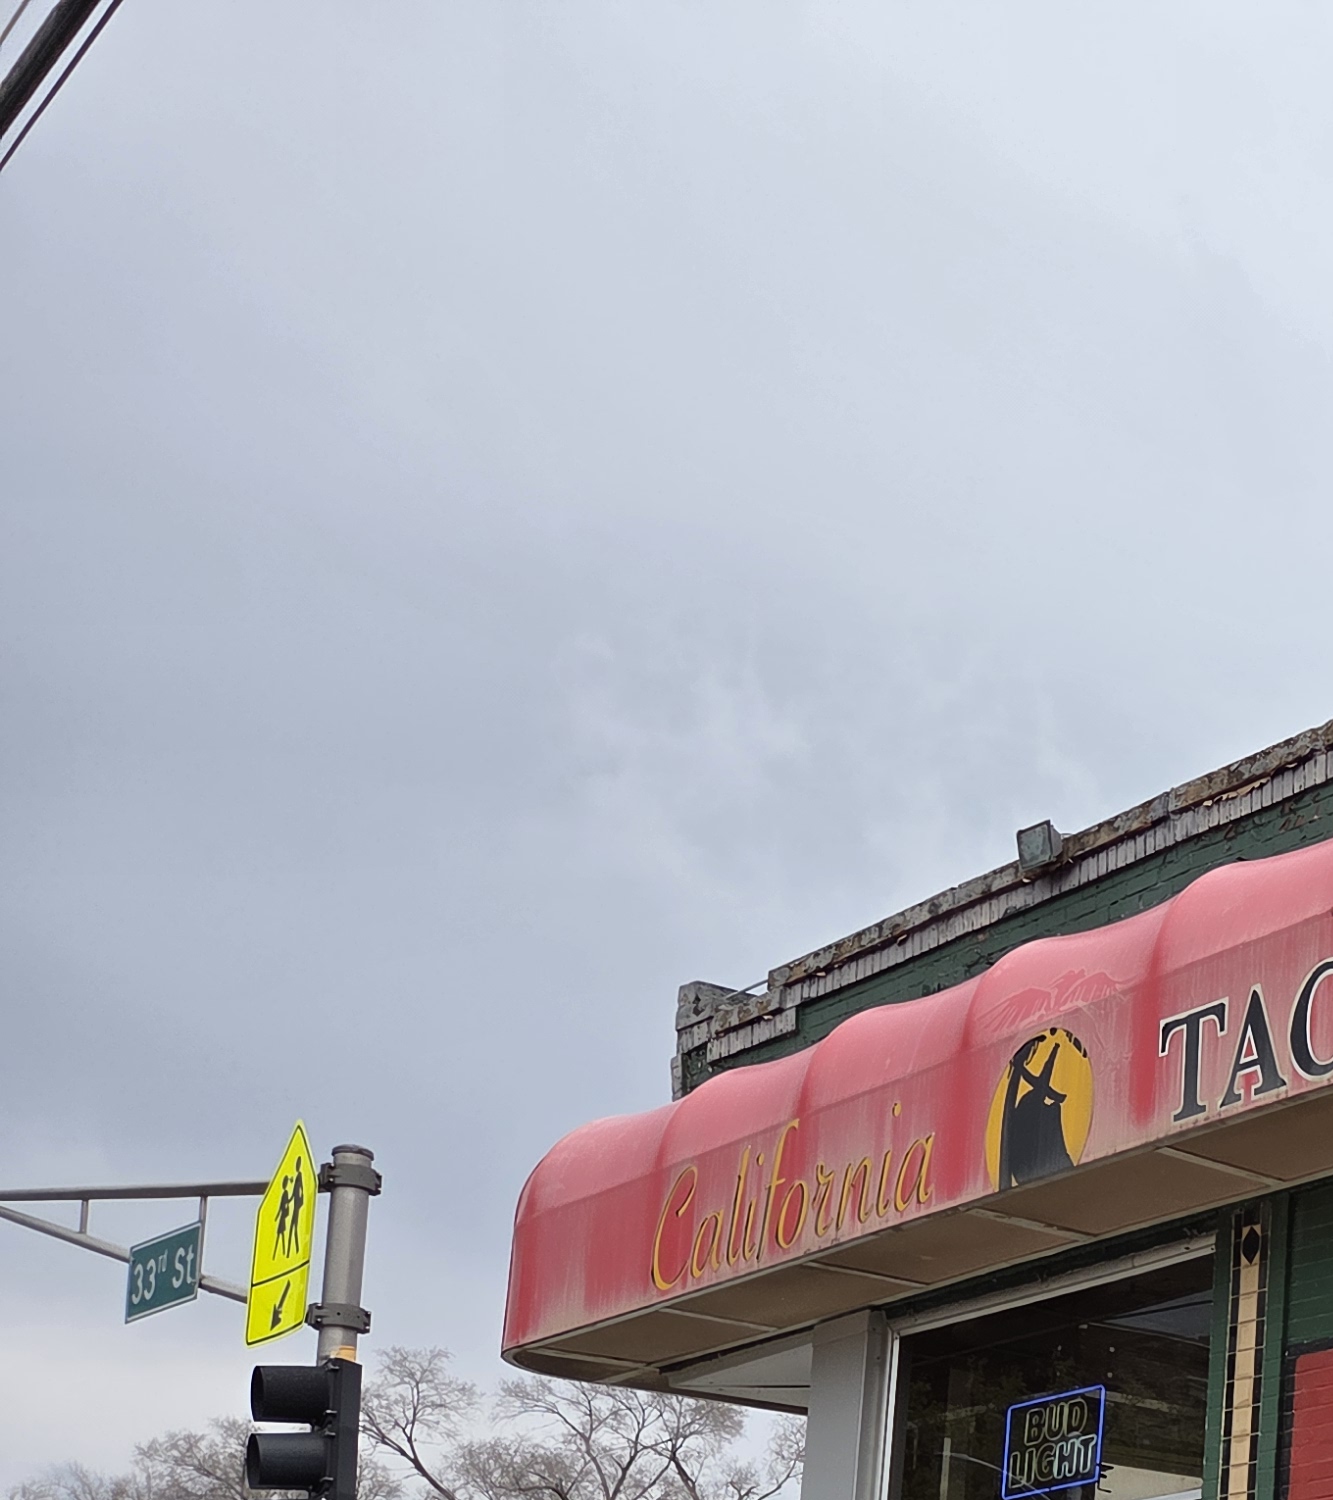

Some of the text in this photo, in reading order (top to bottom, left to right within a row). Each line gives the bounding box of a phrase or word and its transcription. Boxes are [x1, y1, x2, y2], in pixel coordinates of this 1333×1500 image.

[650, 1102, 937, 1291] California
[131, 1243, 195, 1305] 33rd St
[1024, 1396, 1088, 1447] BUD
[1008, 1432, 1098, 1489] LIGHT
